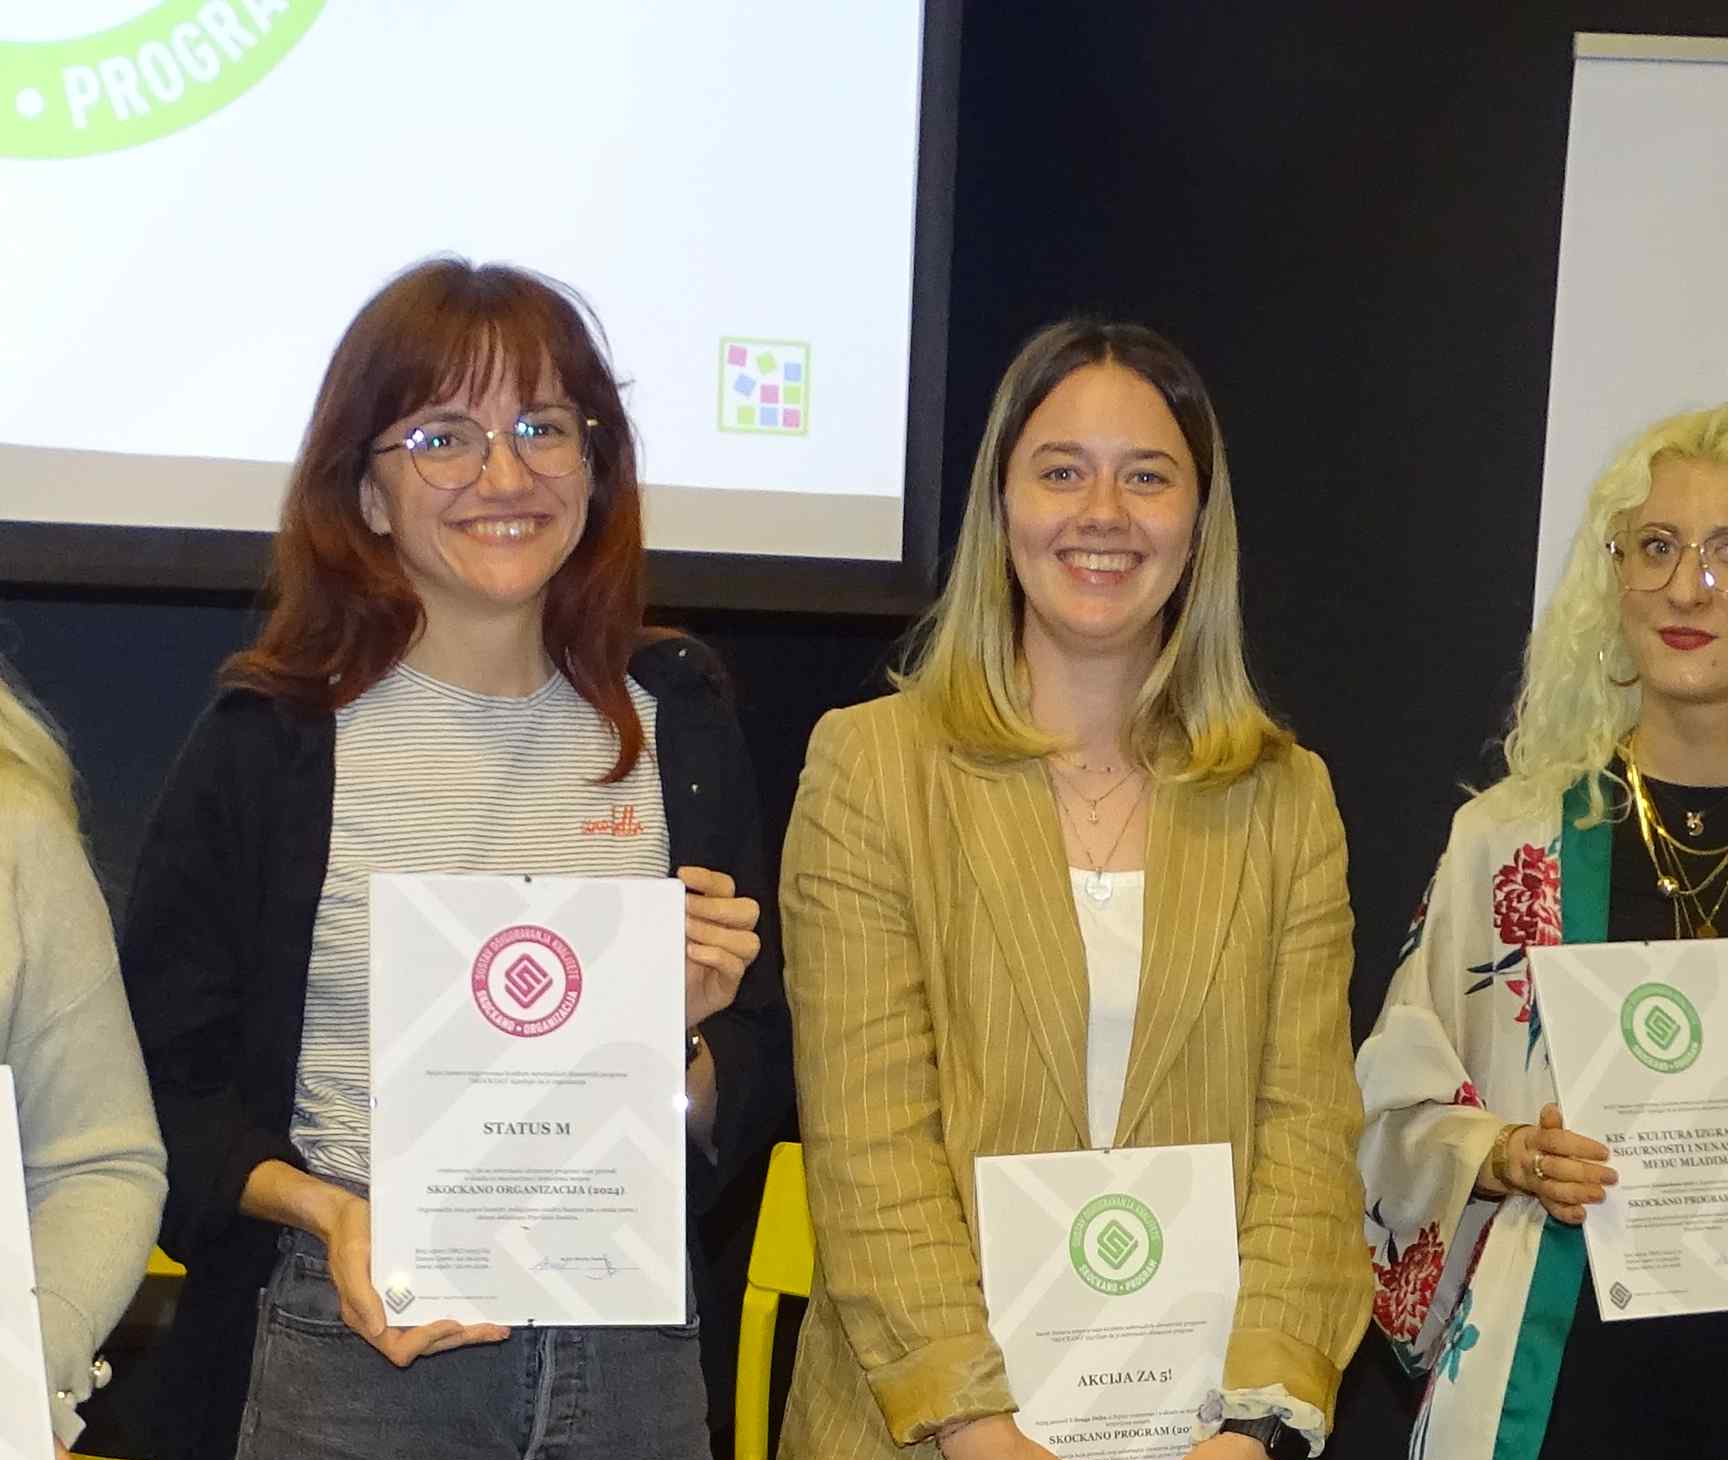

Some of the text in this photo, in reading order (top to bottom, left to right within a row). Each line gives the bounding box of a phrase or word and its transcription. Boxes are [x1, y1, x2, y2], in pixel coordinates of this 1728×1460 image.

[483, 1121, 571, 1135] STATUS M
[426, 1185, 625, 1196] SKOCKANO ORGANIZACIJA (2024)
[1078, 1368, 1173, 1387] AKCIJA ZA 5!
[1049, 1424, 1192, 1445] SKOCKANO PROGRAM (20
